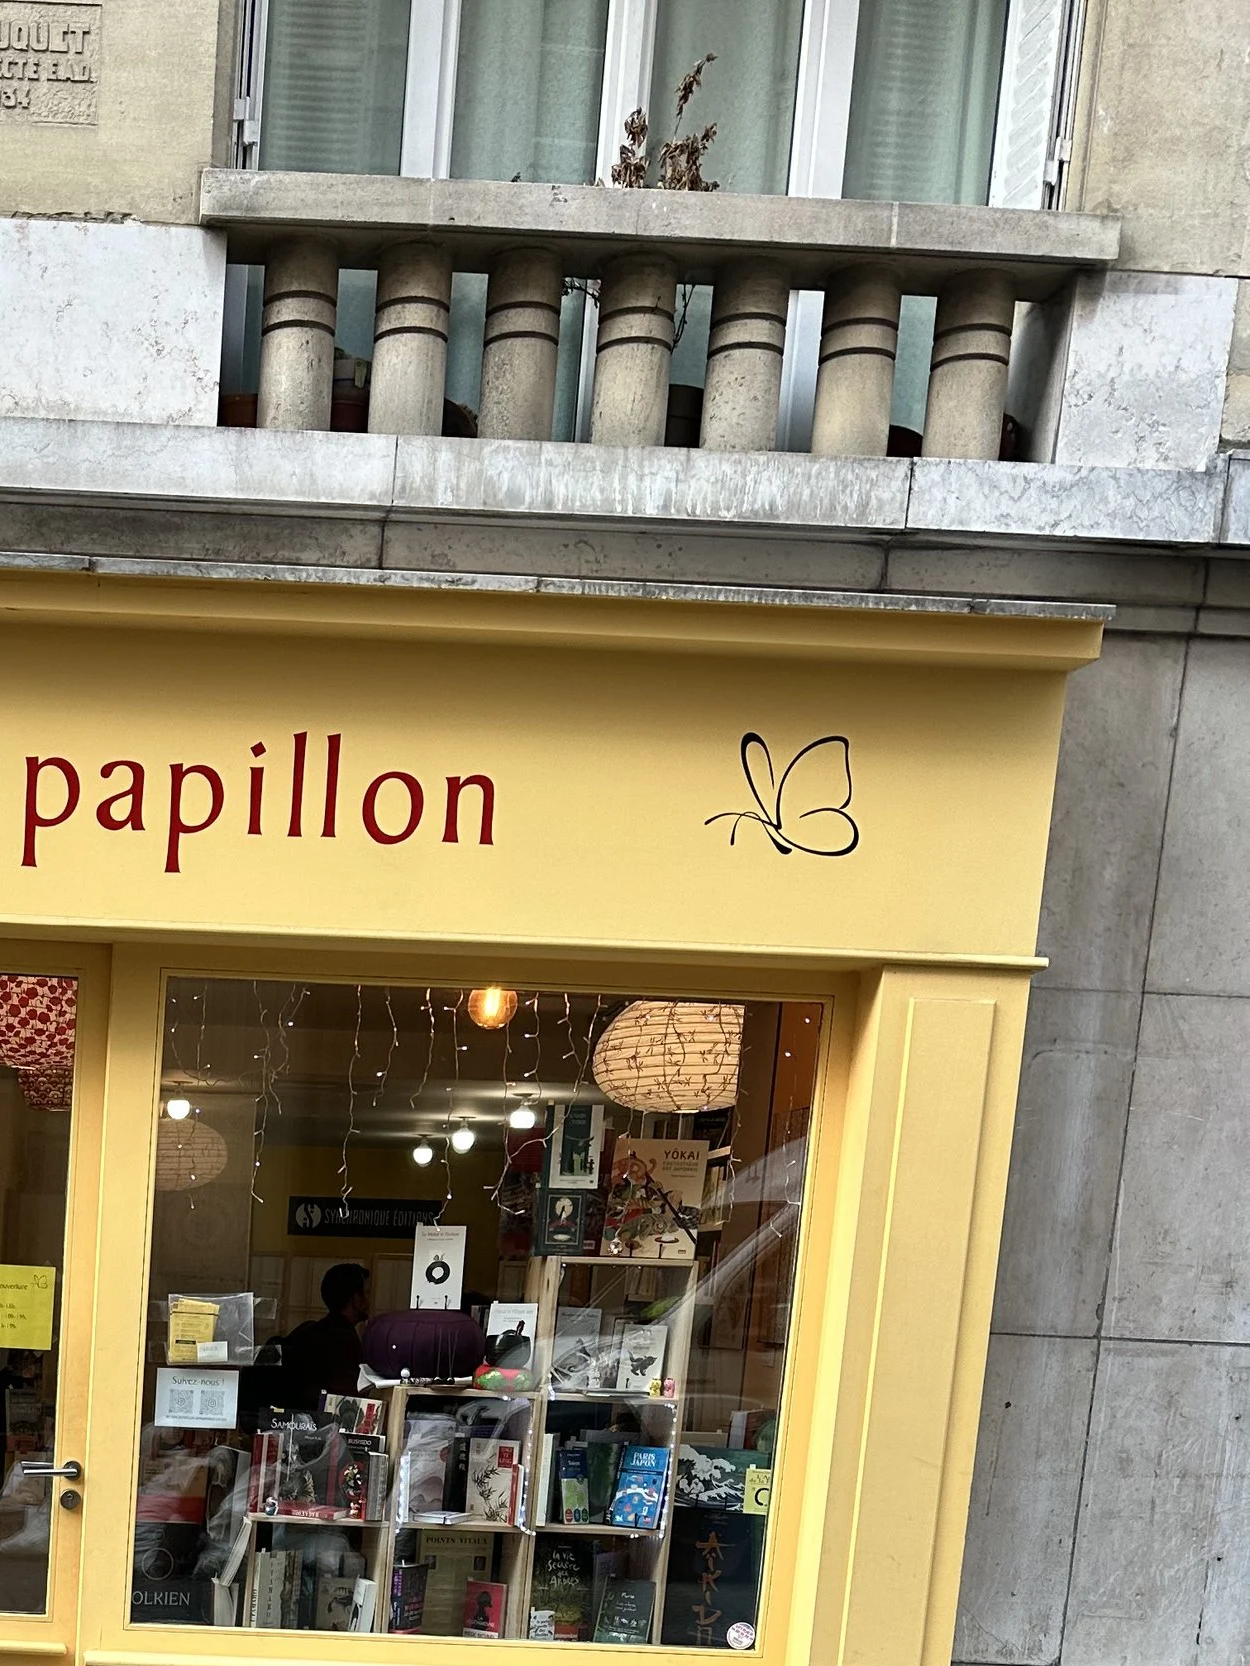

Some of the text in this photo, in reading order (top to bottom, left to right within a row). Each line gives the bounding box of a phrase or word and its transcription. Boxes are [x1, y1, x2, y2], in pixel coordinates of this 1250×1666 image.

[20, 731, 495, 873] papillon
[633, 1452, 656, 1460] PARIS
[132, 1591, 190, 1606] OLKIEN
